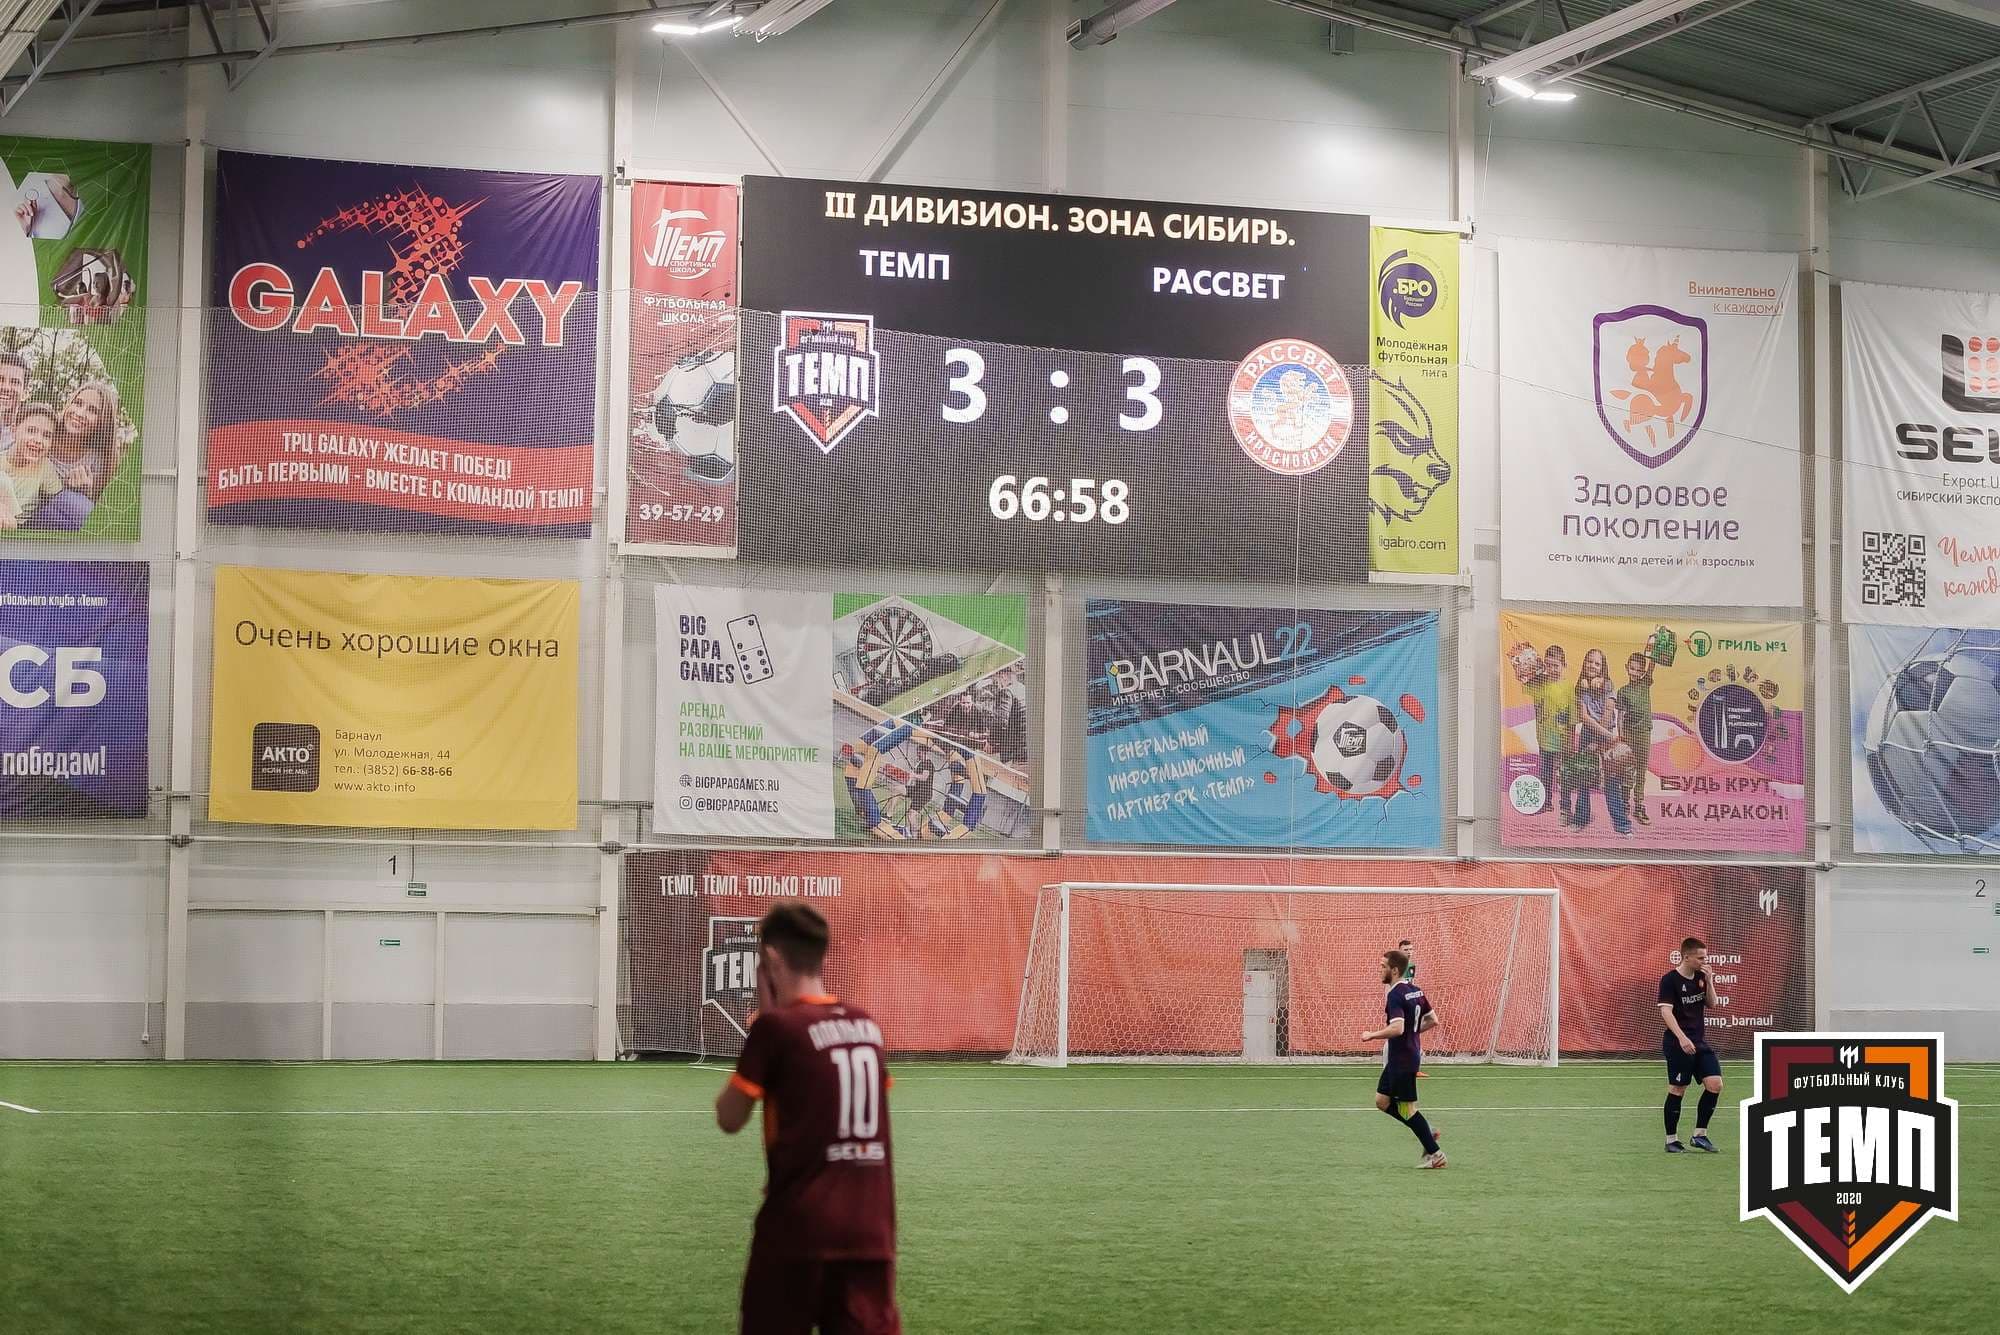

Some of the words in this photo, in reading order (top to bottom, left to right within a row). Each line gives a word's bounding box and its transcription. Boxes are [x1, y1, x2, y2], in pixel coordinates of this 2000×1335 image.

[864, 195, 1059, 231] ДИВИЗИОН.
[1068, 207, 1154, 237] ЗОНА
[1163, 214, 1296, 246] СИБИРЬ.
[859, 249, 950, 280] ТЕМП
[1153, 267, 1285, 300] РАССВЕТ
[1688, 281, 1776, 298] Внимательно
[228, 262, 582, 346] GALAXY
[644, 297, 726, 311] ФУТБОЛЬНАЯ
[662, 312, 705, 324] ШКОЛА
[1376, 336, 1448, 352] Молодёжная
[1243, 345, 1341, 383] РАССВЕТ
[1378, 351, 1448, 365] футбольная
[785, 352, 870, 402] ТЕМП
[942, 348, 987, 423] 3
[1119, 357, 1164, 431] 3
[282, 432, 314, 455] ТРЦ
[318, 434, 379, 458] GALAXY
[384, 442, 449, 471] ЖЕЛАЕТ
[453, 453, 512, 481] ПОБЕД!
[218, 465, 263, 489] БЫТЬ
[268, 463, 349, 485] ПЕРВЫМИ
[366, 468, 427, 497] ВМЕСТЕ
[432, 480, 442, 499] С
[446, 481, 535, 510] КОМАНДОЙ
[539, 488, 584, 510] ТЕМП!
[1574, 474, 1729, 509] Здоровое
[1943, 473, 1986, 491] Export
[989, 475, 1130, 524] 66:58
[1896, 490, 1963, 505] СИБИРСКИЙ
[639, 504, 725, 522] 39-57-29
[1562, 514, 1740, 542] поколение
[1378, 535, 1446, 551] ligabro.com
[1548, 554, 1572, 562] сеть
[1575, 555, 1615, 564] клиник
[1618, 556, 1638, 566] для
[1641, 555, 1674, 567] детей
[1676, 558, 1683, 566] и
[1702, 558, 1755, 569] взрослых
[48, 594, 75, 608] клуба
[679, 614, 707, 636] BIG
[234, 620, 331, 651] Очень
[341, 632, 479, 659] хорошие
[488, 638, 560, 659] окна
[1717, 639, 1762, 652] ГРИЛЬ
[679, 639, 721, 661] PAPA
[679, 660, 735, 684] GAMES
[679, 701, 726, 720] АРЕНДА
[335, 729, 382, 742] Барнаул
[679, 721, 764, 741] РАЗВЛЕЧЕНИЙ
[679, 742, 696, 757] НА
[699, 744, 732, 760] ВАШЕ
[735, 745, 819, 763] МЕРОПРИЯТИЕ
[1108, 723, 1209, 763] ГЕНЕРАЛЬНЫЙ
[2, 745, 106, 779] победам!
[261, 746, 310, 763] АКТО
[334, 747, 350, 759] ул.
[354, 747, 434, 761] Молодежная,
[437, 750, 451, 760] 44
[363, 764, 399, 778] (3852)
[402, 766, 453, 777] 66-88-66
[1107, 745, 1246, 794] ИНФОРМАЦИОННЫЙ
[334, 780, 416, 793] www.akto.info
[695, 776, 780, 791] BIGPAPAGAMES.RU
[1725, 777, 1777, 796] КРУТ,
[695, 798, 779, 813] @BIGPAPAGAMES
[1107, 792, 1171, 822] ПАРТНЕР
[1174, 786, 1199, 807] ФК
[1202, 776, 1256, 801] «ТЕМП»
[1660, 802, 1699, 819] КАК
[1704, 804, 1789, 822] ДРАКОН!
[660, 874, 698, 897] ТЕМП,
[703, 874, 742, 897] ТЕМП,
[746, 875, 799, 897] ТОЛЬКО
[802, 876, 842, 897] ТЕМП!
[1975, 879, 1986, 898] 2
[1703, 953, 1741, 967] emp.ru
[712, 951, 760, 992] ТЕМ
[1703, 1015, 1773, 1028] emp_barnaul
[830, 1046, 879, 1139] 10
